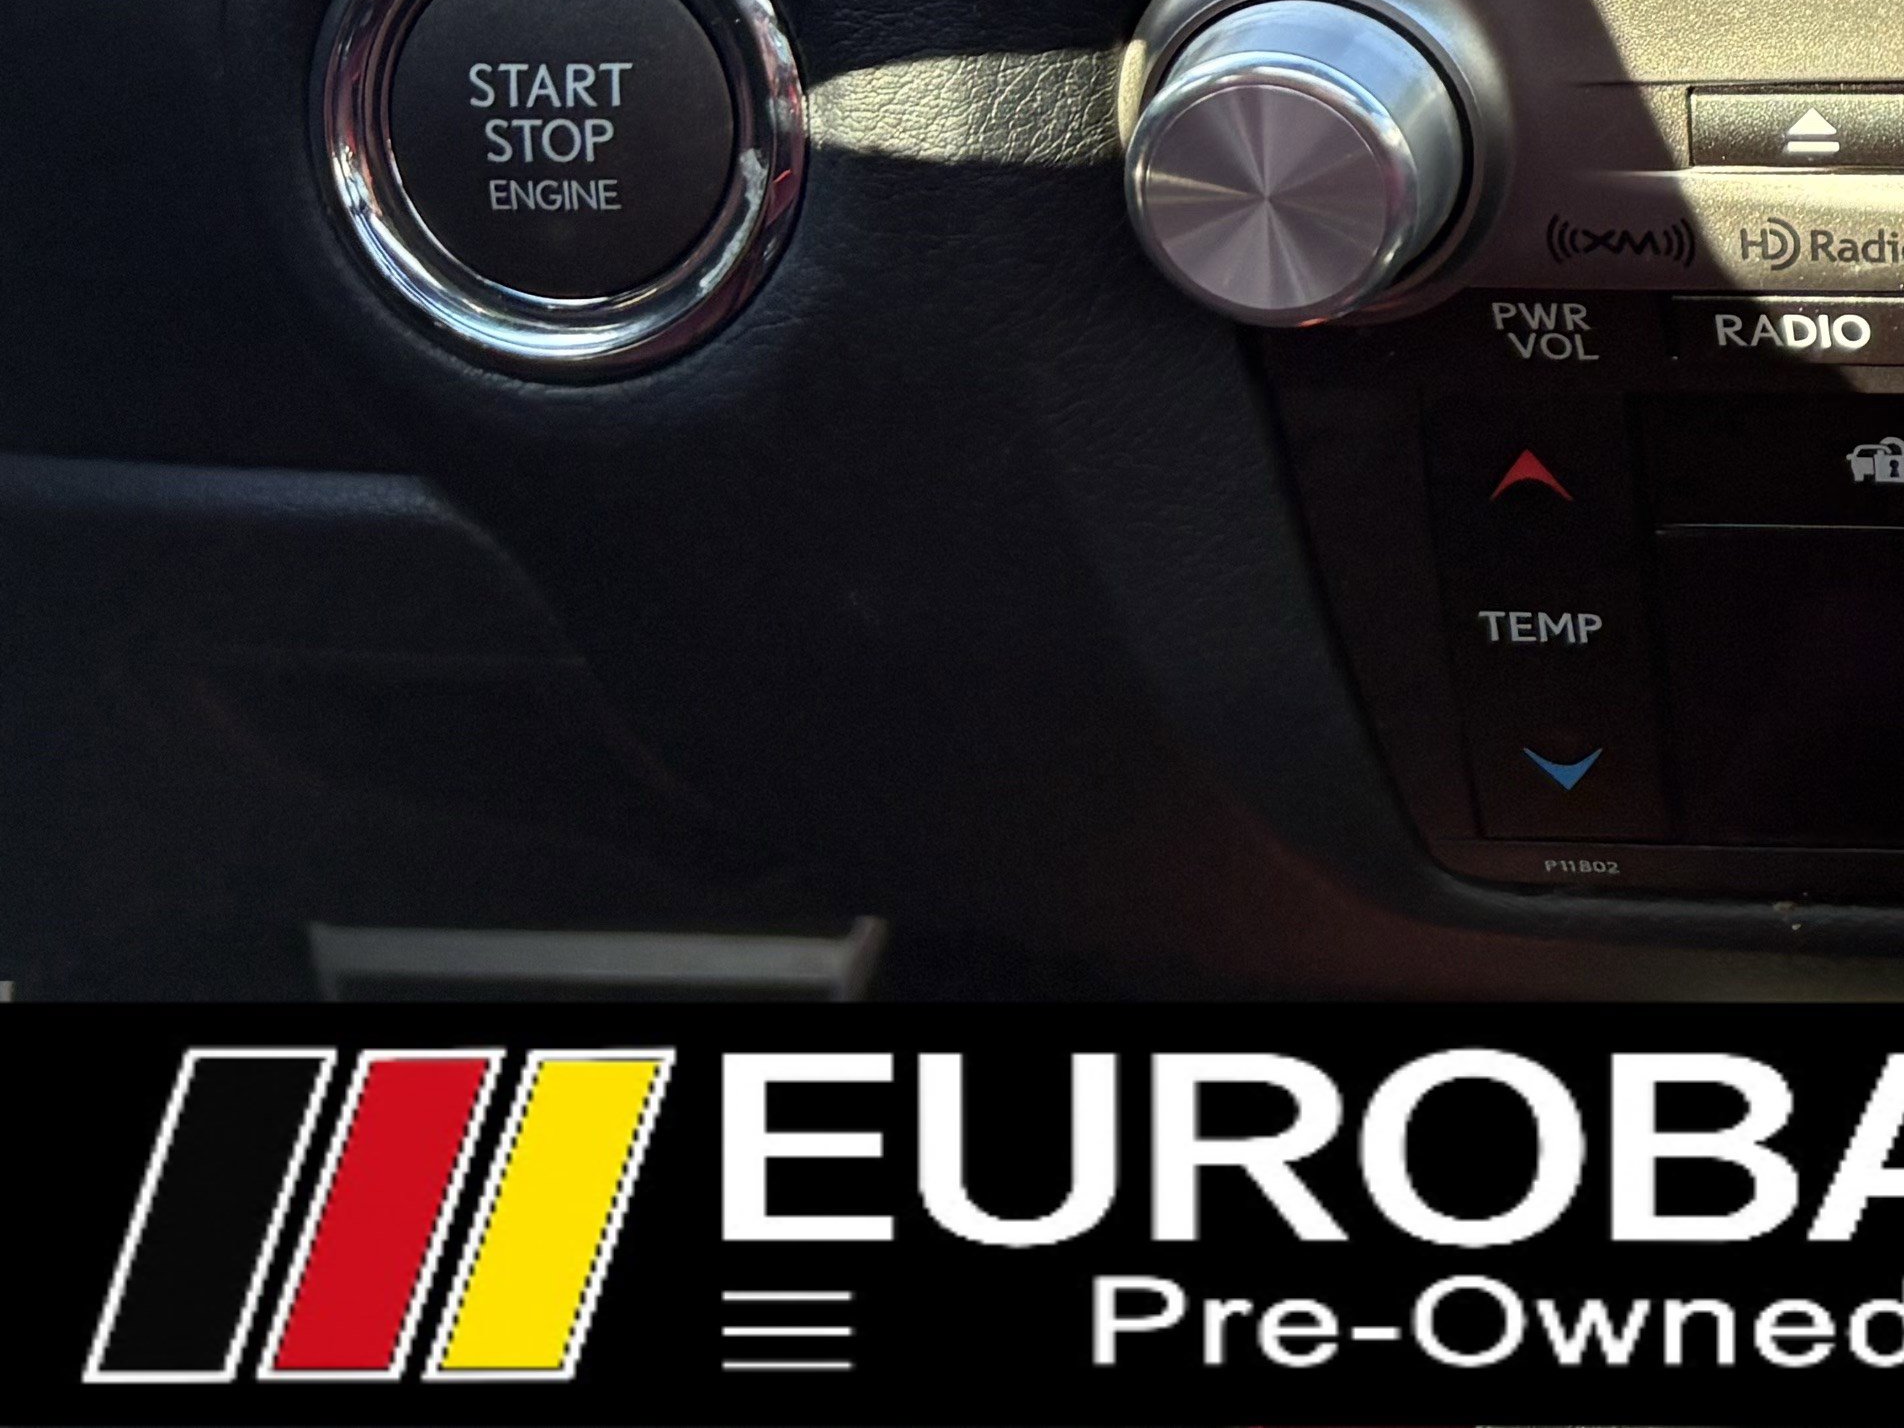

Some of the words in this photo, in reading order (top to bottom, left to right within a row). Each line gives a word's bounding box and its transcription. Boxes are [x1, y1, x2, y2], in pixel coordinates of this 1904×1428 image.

[468, 62, 633, 108] START
[484, 118, 615, 164] STOP
[489, 179, 622, 211] ENGINE
[1491, 301, 1591, 332] PWR
[1715, 313, 1872, 350] RADIO
[1507, 331, 1600, 362] VOL
[1478, 610, 1603, 644] TEMP
